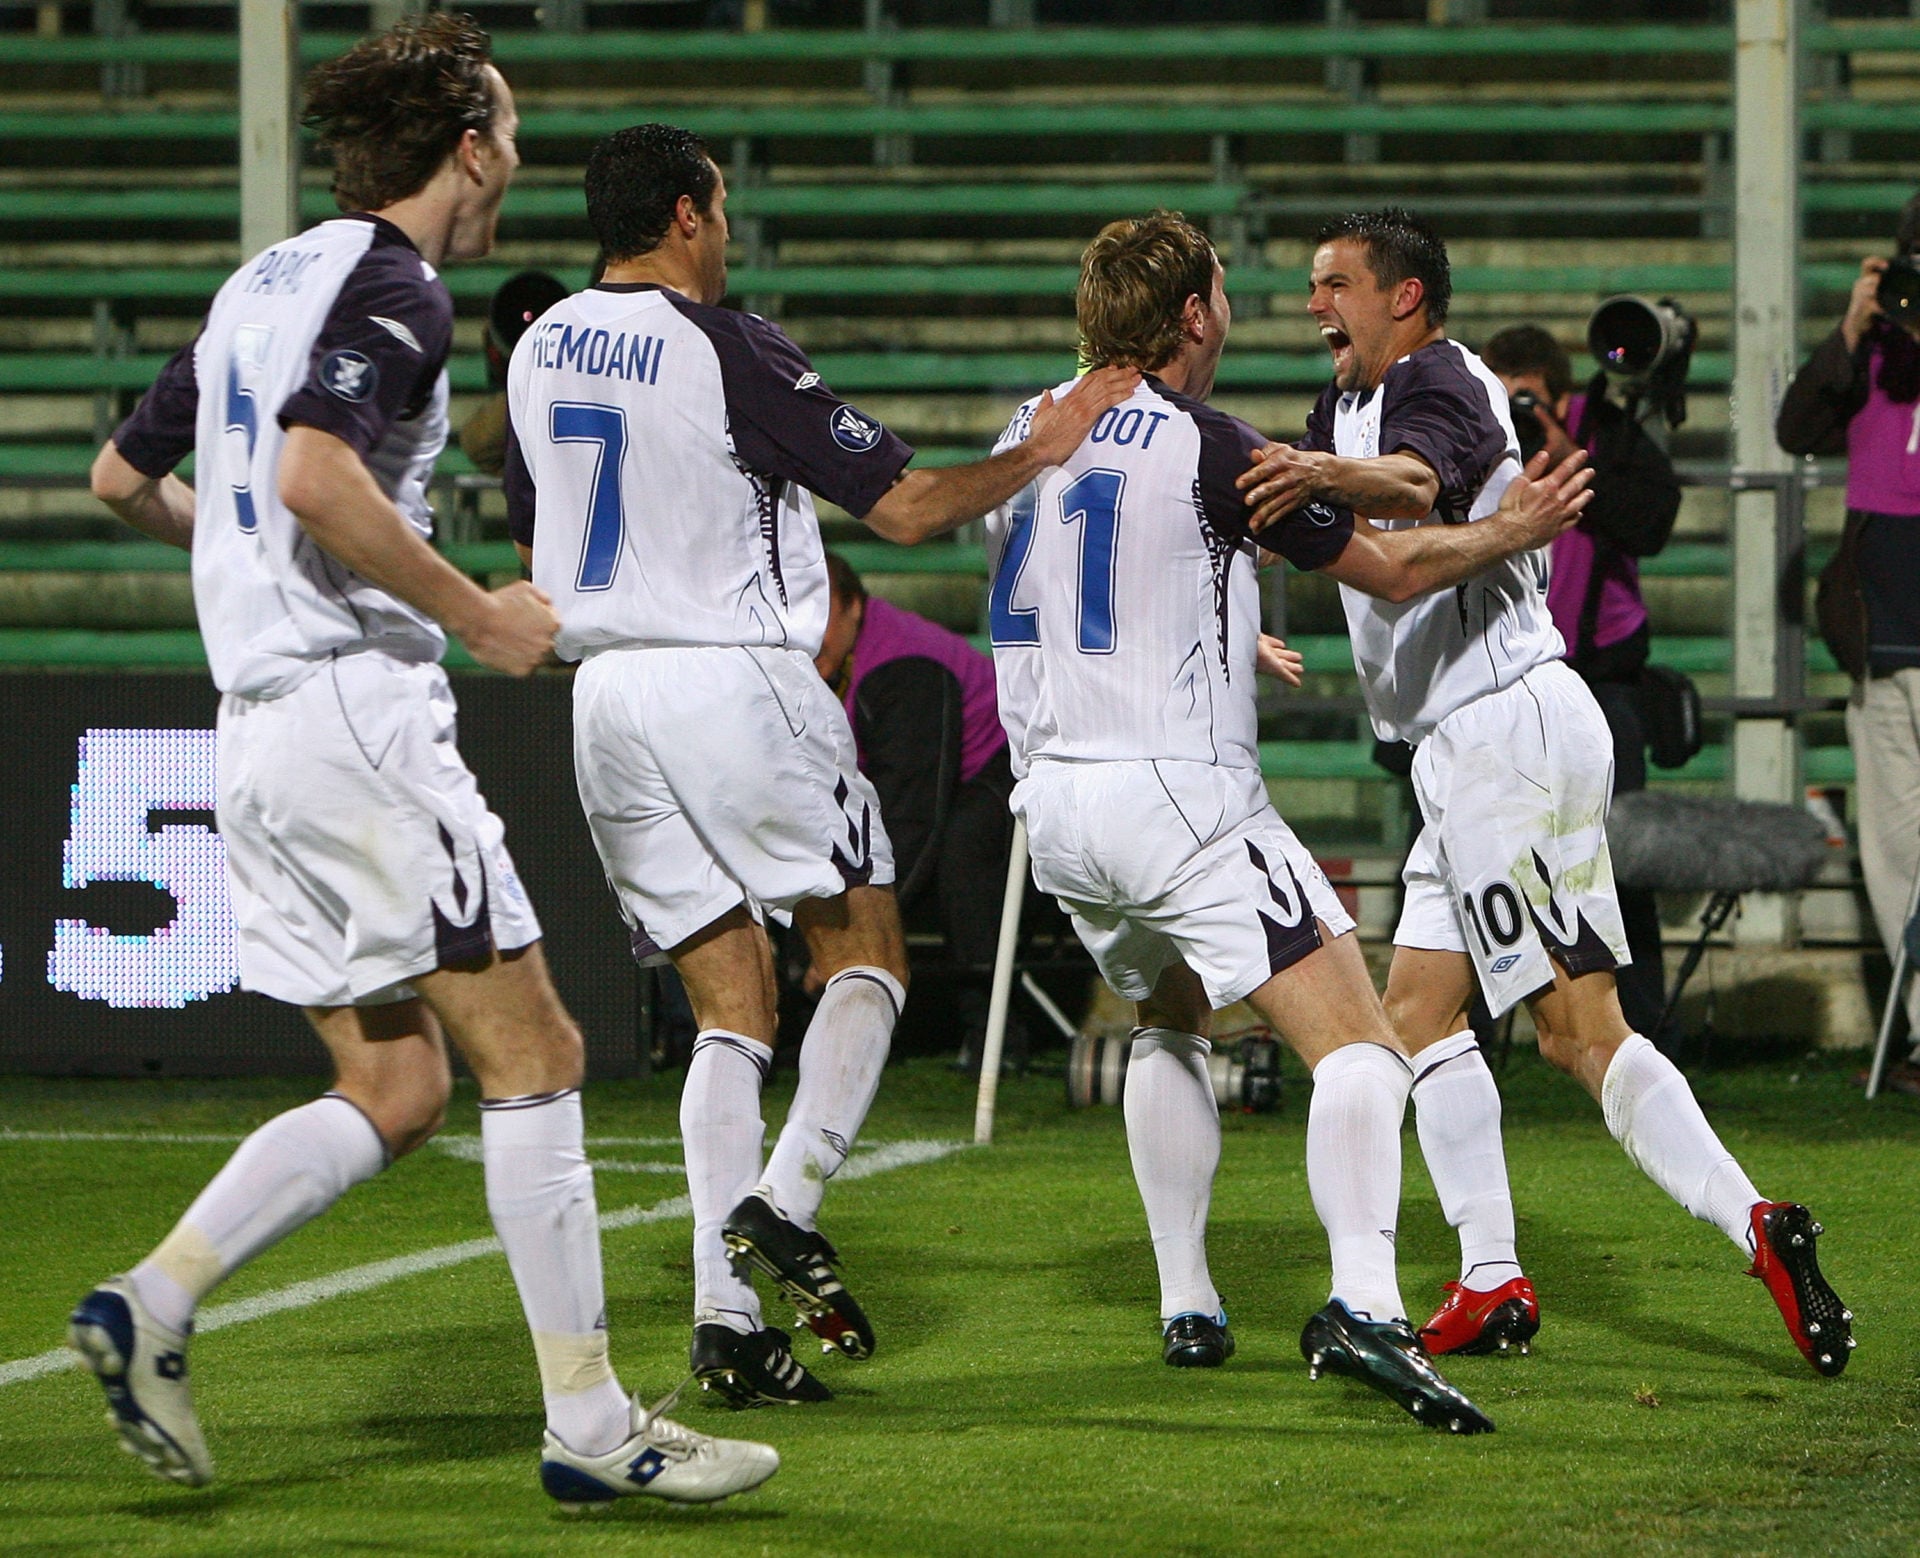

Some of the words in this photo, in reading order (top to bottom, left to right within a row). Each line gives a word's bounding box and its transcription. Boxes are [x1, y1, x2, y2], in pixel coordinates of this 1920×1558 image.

[533, 322, 665, 386] HEMDANI
[549, 401, 628, 593] 7
[988, 467, 1127, 656] 21
[47, 728, 242, 1009] 5
[1462, 880, 1524, 959] 10
